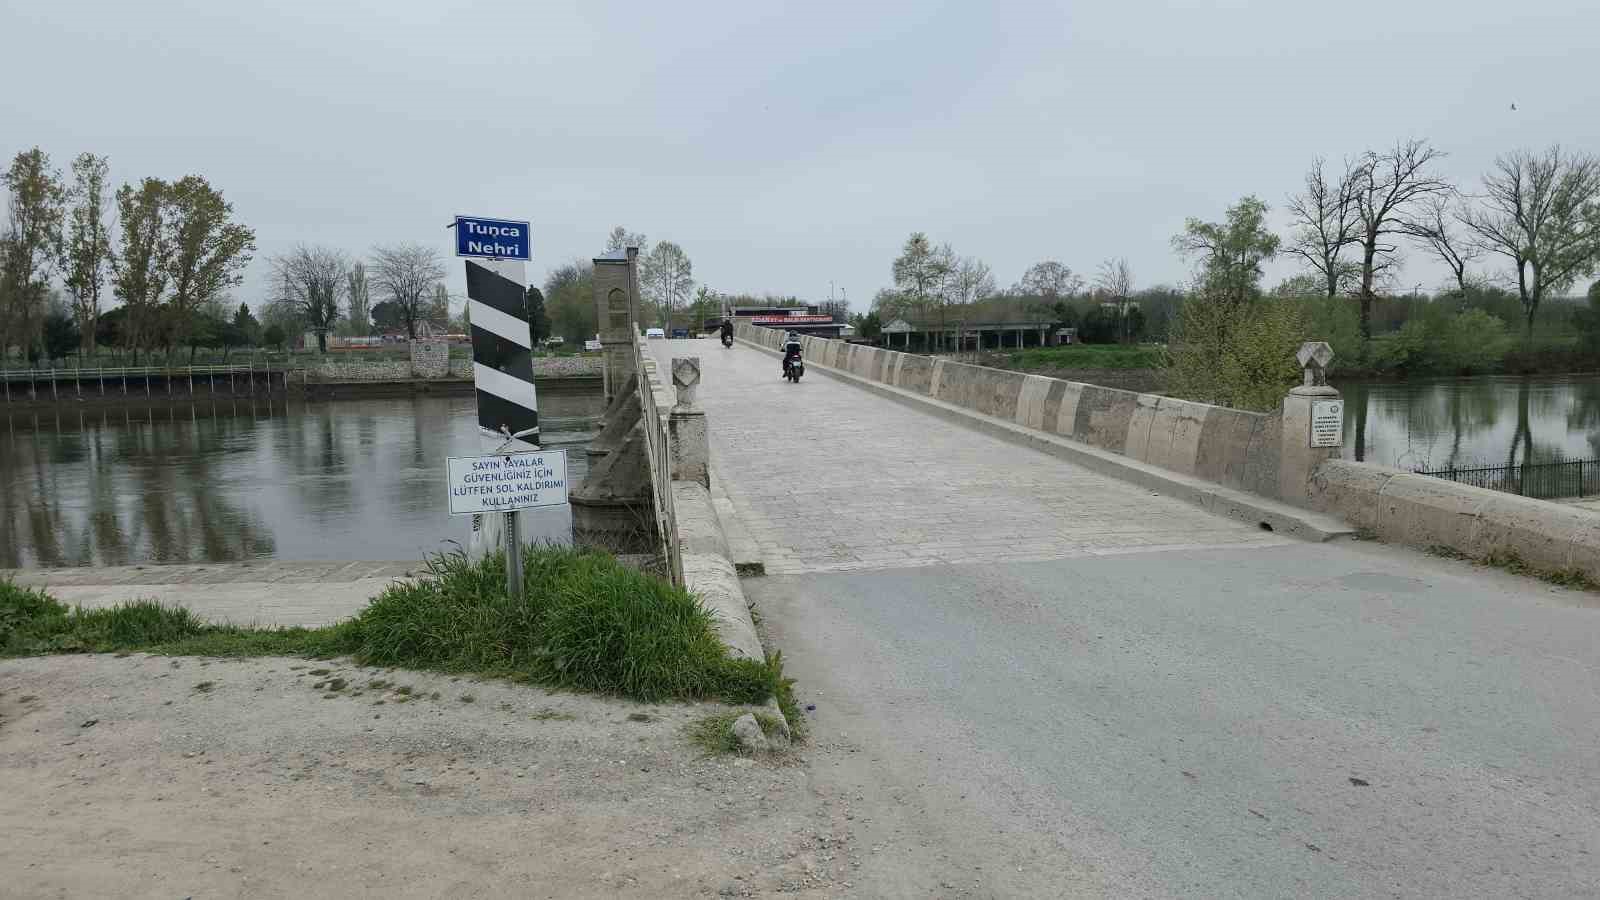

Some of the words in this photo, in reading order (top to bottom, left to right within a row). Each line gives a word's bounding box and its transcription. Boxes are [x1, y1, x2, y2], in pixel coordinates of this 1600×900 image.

[465, 221, 520, 237] Tunca
[468, 241, 519, 256] Nehri
[472, 461, 500, 471] SAYIN
[503, 457, 545, 469] YAYALAR
[534, 467, 553, 479] İÇİN
[454, 485, 493, 496] LÜTFEN
[496, 483, 513, 494] SOL
